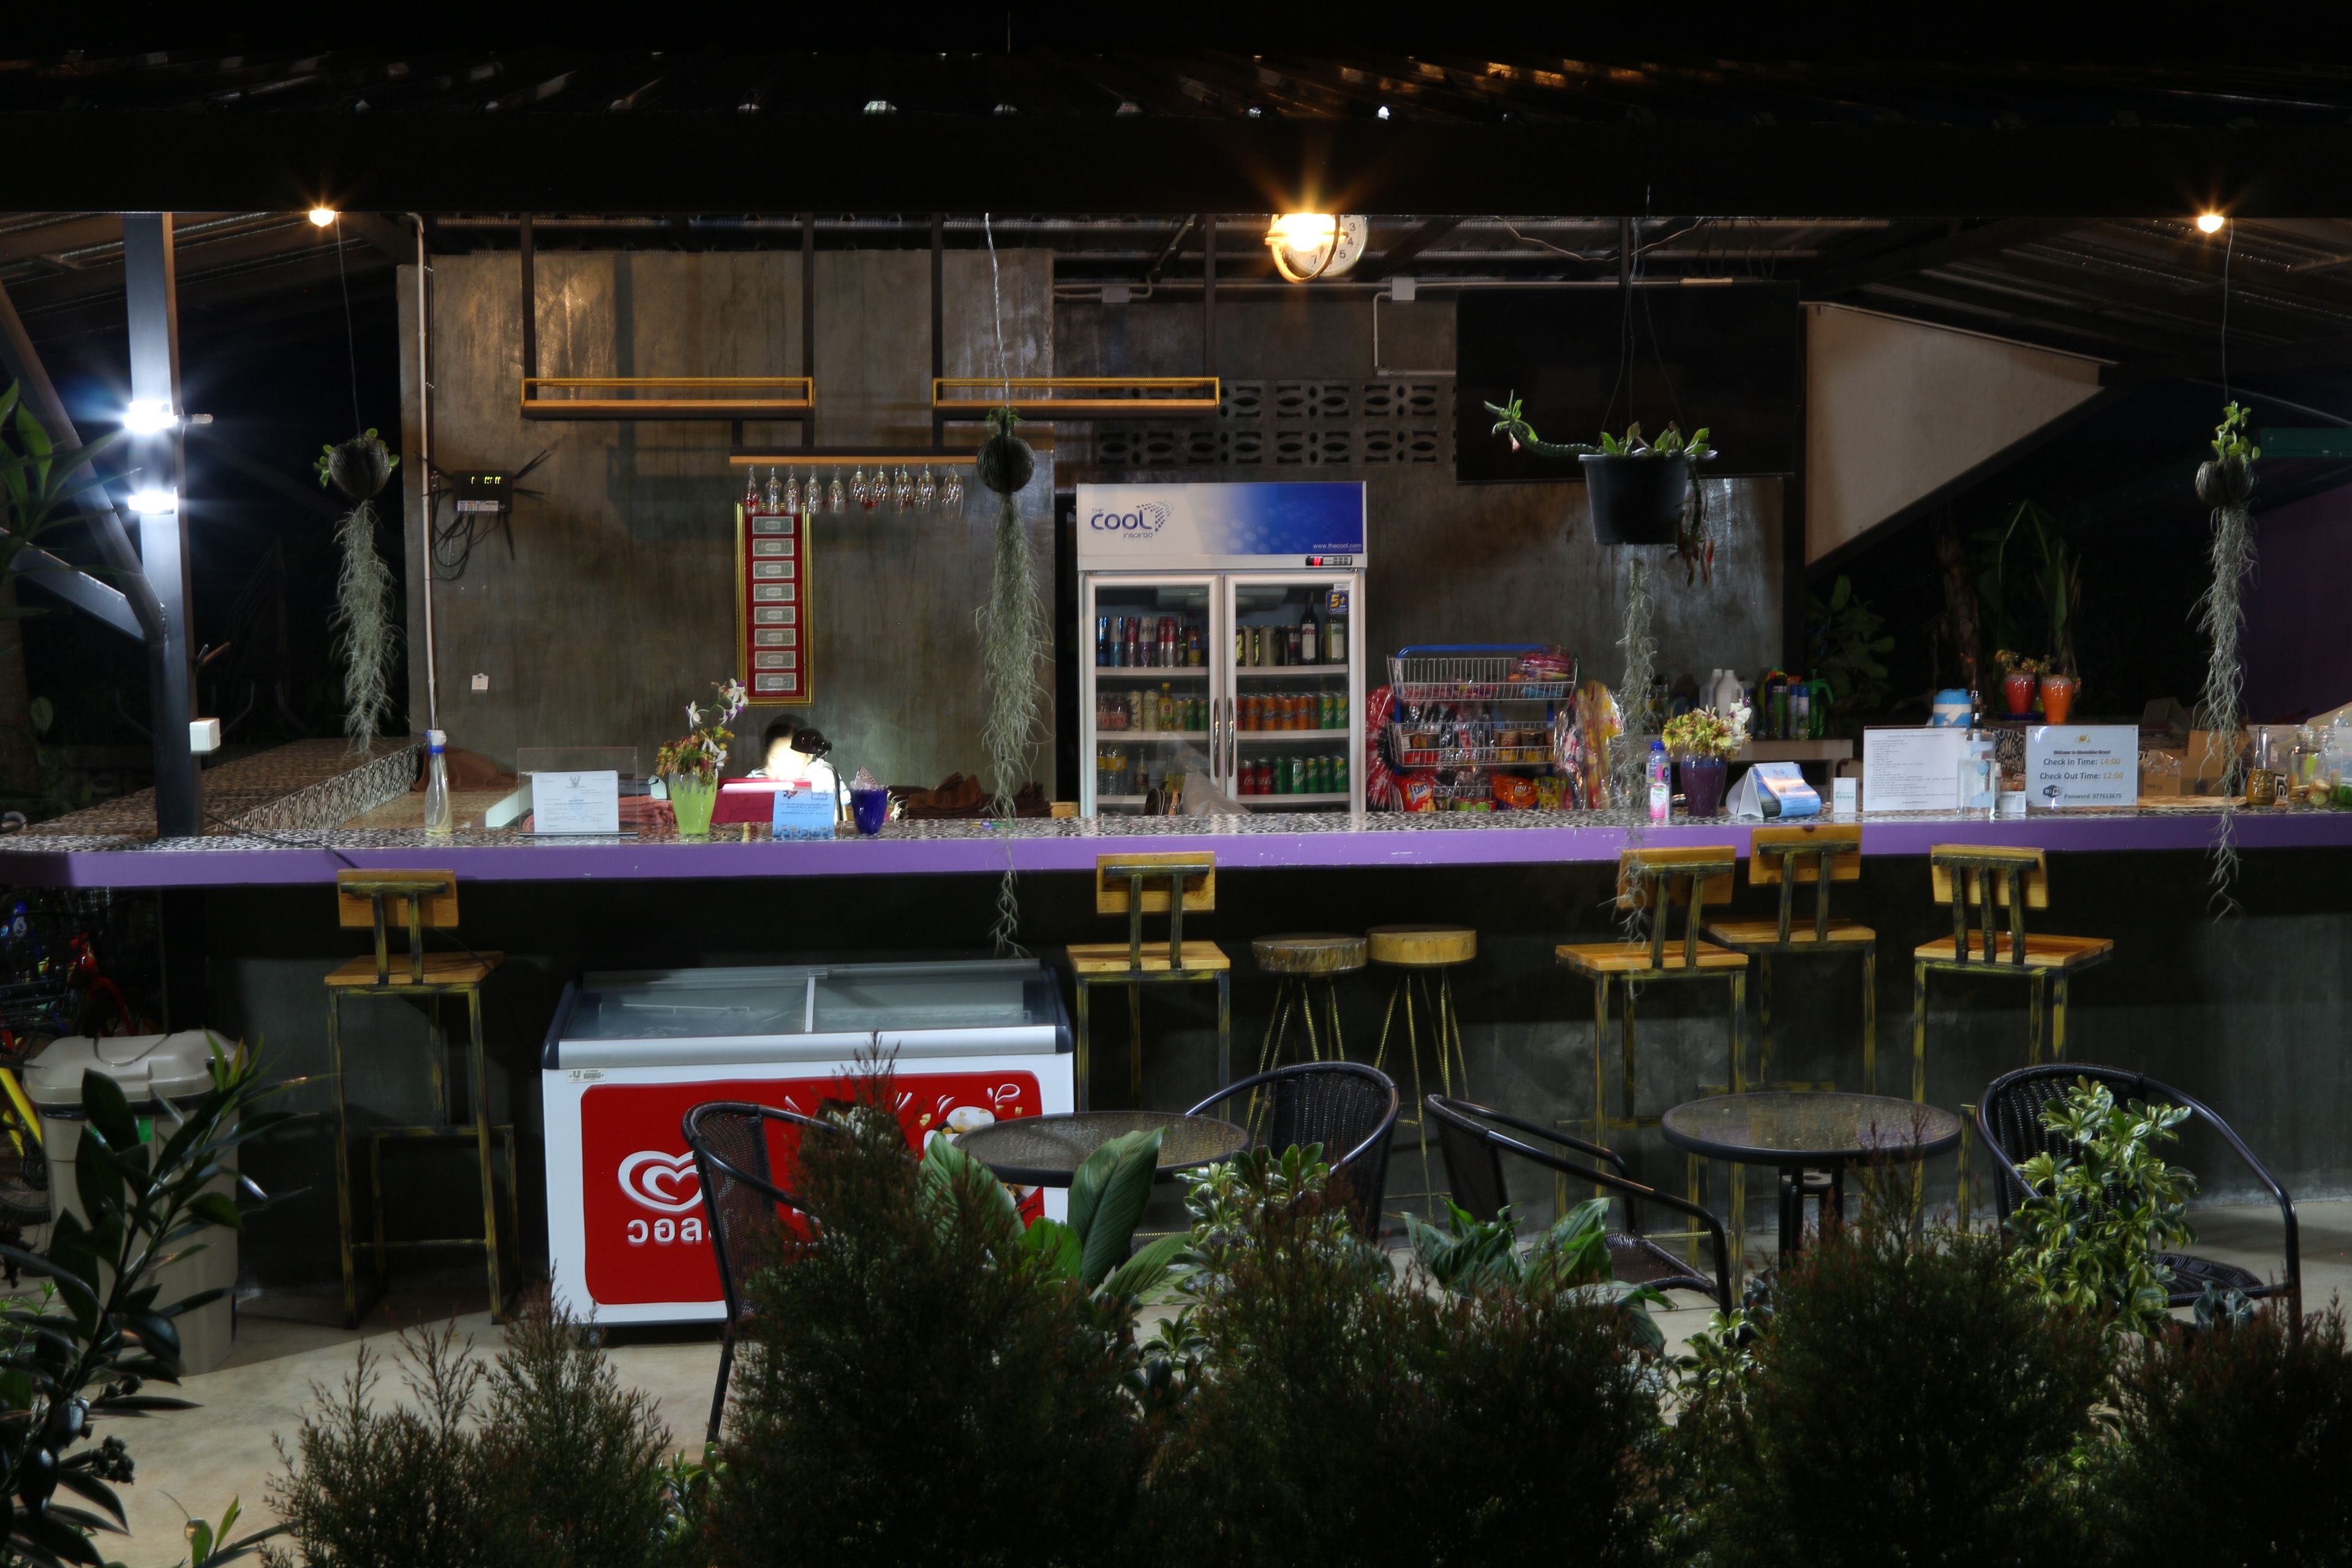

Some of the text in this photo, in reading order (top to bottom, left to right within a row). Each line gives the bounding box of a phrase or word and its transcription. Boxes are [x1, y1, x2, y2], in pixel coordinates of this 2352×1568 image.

[1349, 222, 1355, 231] 3
[1340, 249, 1346, 258] 5
[1311, 255, 1317, 265] 7
